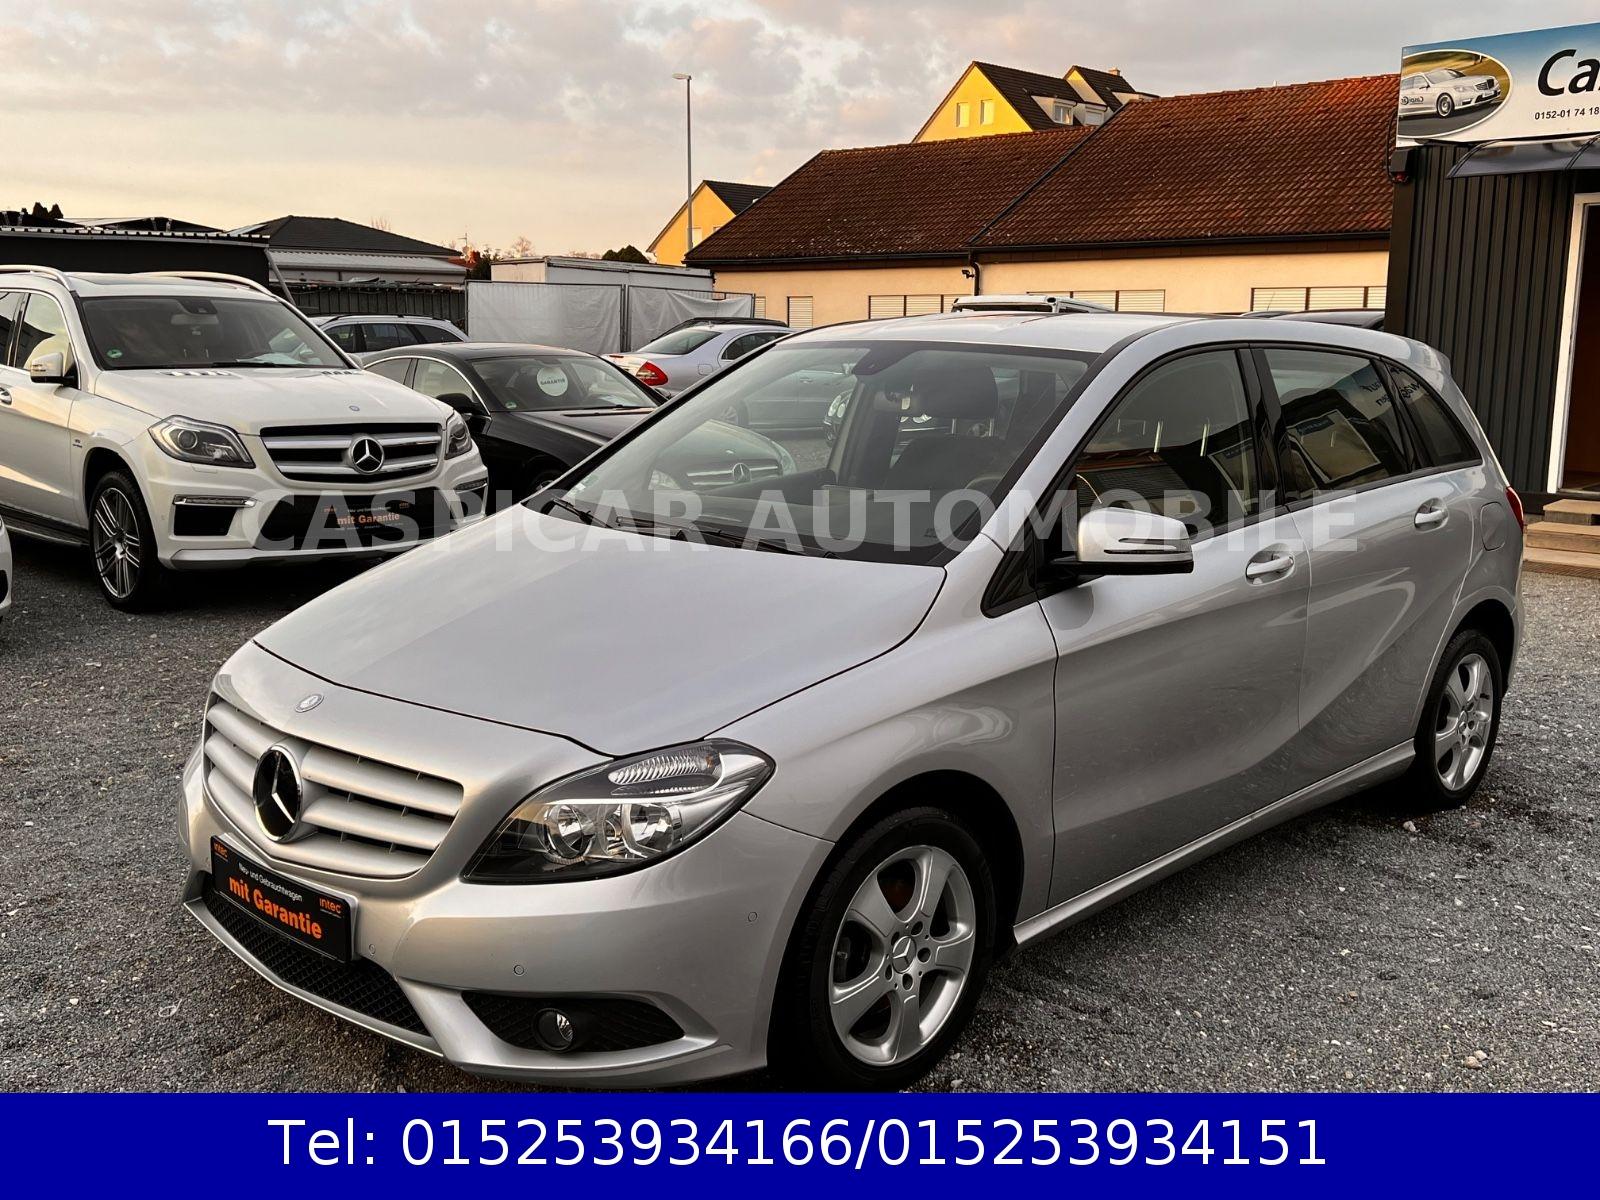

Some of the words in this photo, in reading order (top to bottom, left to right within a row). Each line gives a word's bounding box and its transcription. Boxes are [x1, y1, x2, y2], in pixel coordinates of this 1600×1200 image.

[1537, 48, 1600, 97] Ca
[1534, 109, 1571, 120] 0152-01
[1574, 107, 1586, 118] 74
[1588, 105, 1600, 116] 18
[337, 516, 355, 525] mit
[359, 513, 400, 524] Garantie
[250, 870, 259, 881] und
[259, 873, 303, 903] Gebrauchtwagen
[229, 876, 250, 903] mit
[253, 888, 322, 939] Garantie
[319, 897, 342, 914] intec
